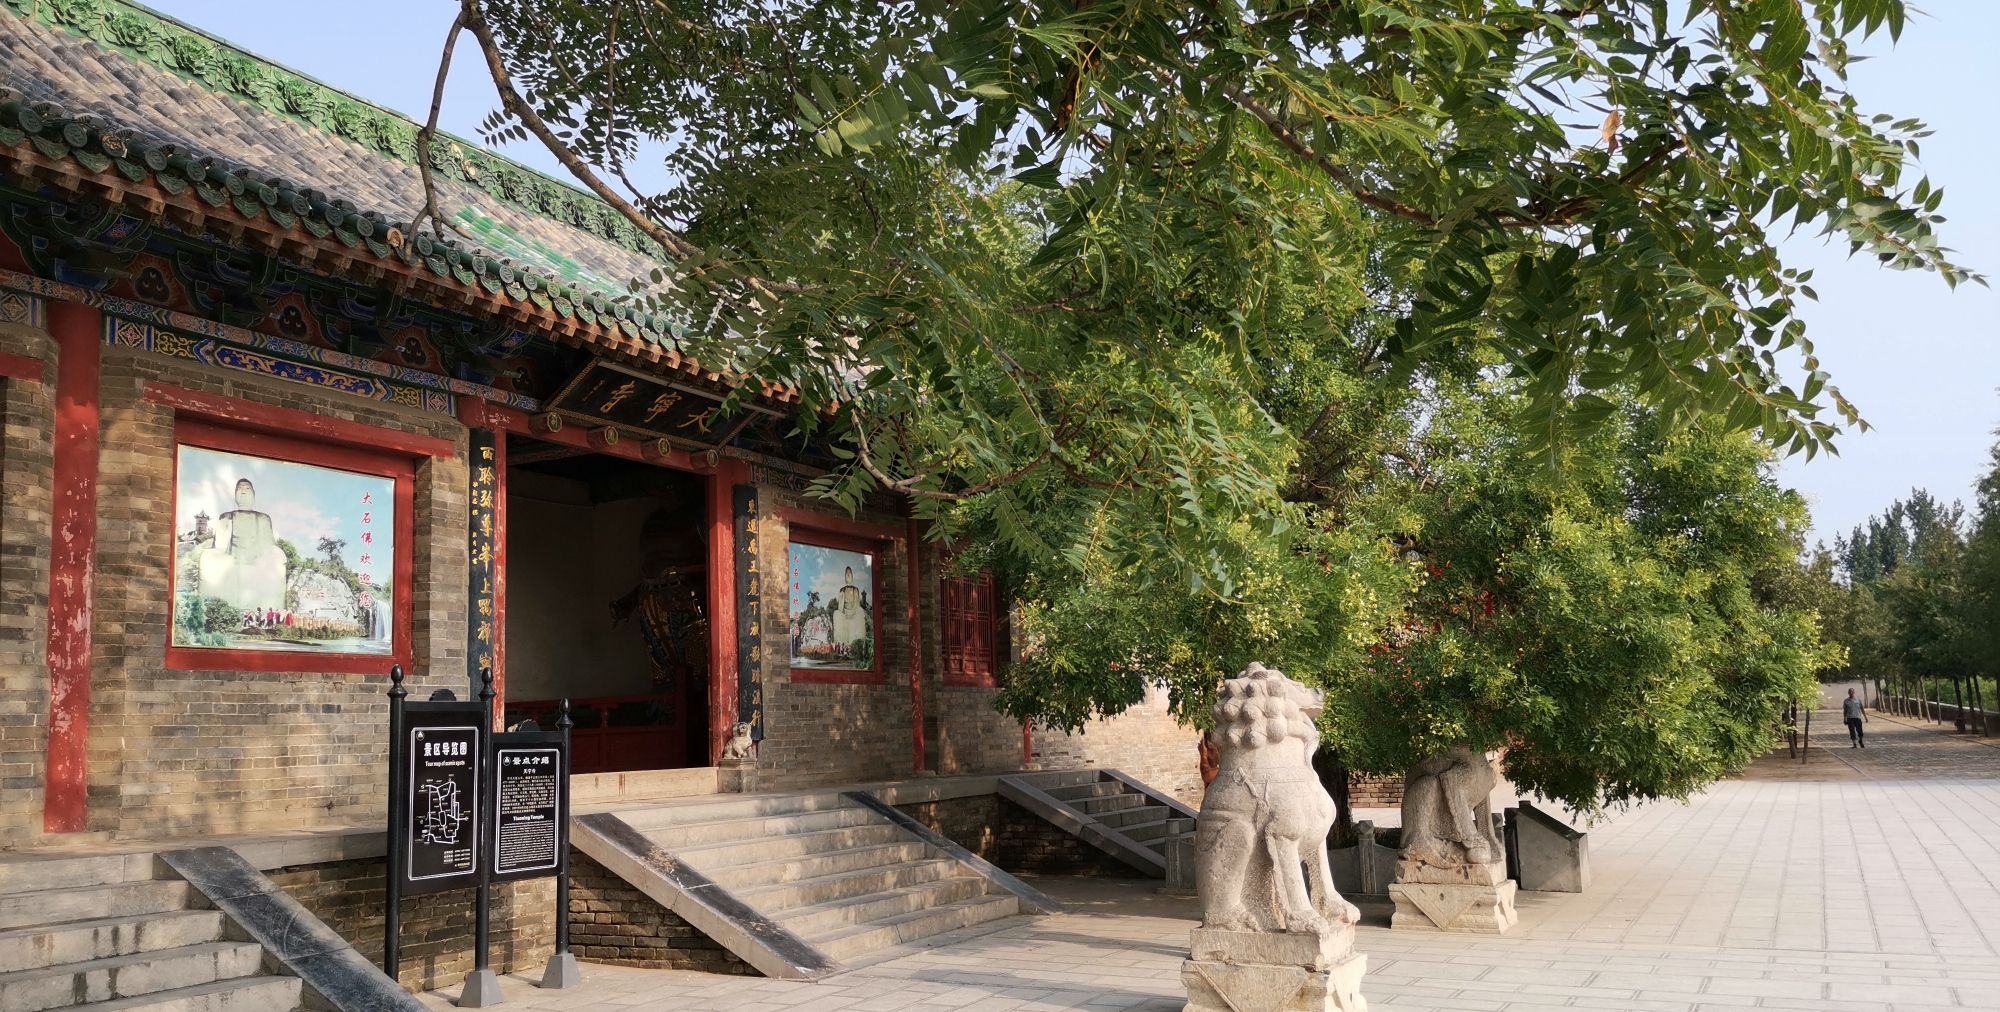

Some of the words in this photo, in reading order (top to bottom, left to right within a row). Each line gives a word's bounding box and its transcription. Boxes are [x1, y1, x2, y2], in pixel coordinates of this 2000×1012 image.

[361, 492, 373, 608] 大石佛欢迎您
[424, 742, 468, 757] 景区导览图
